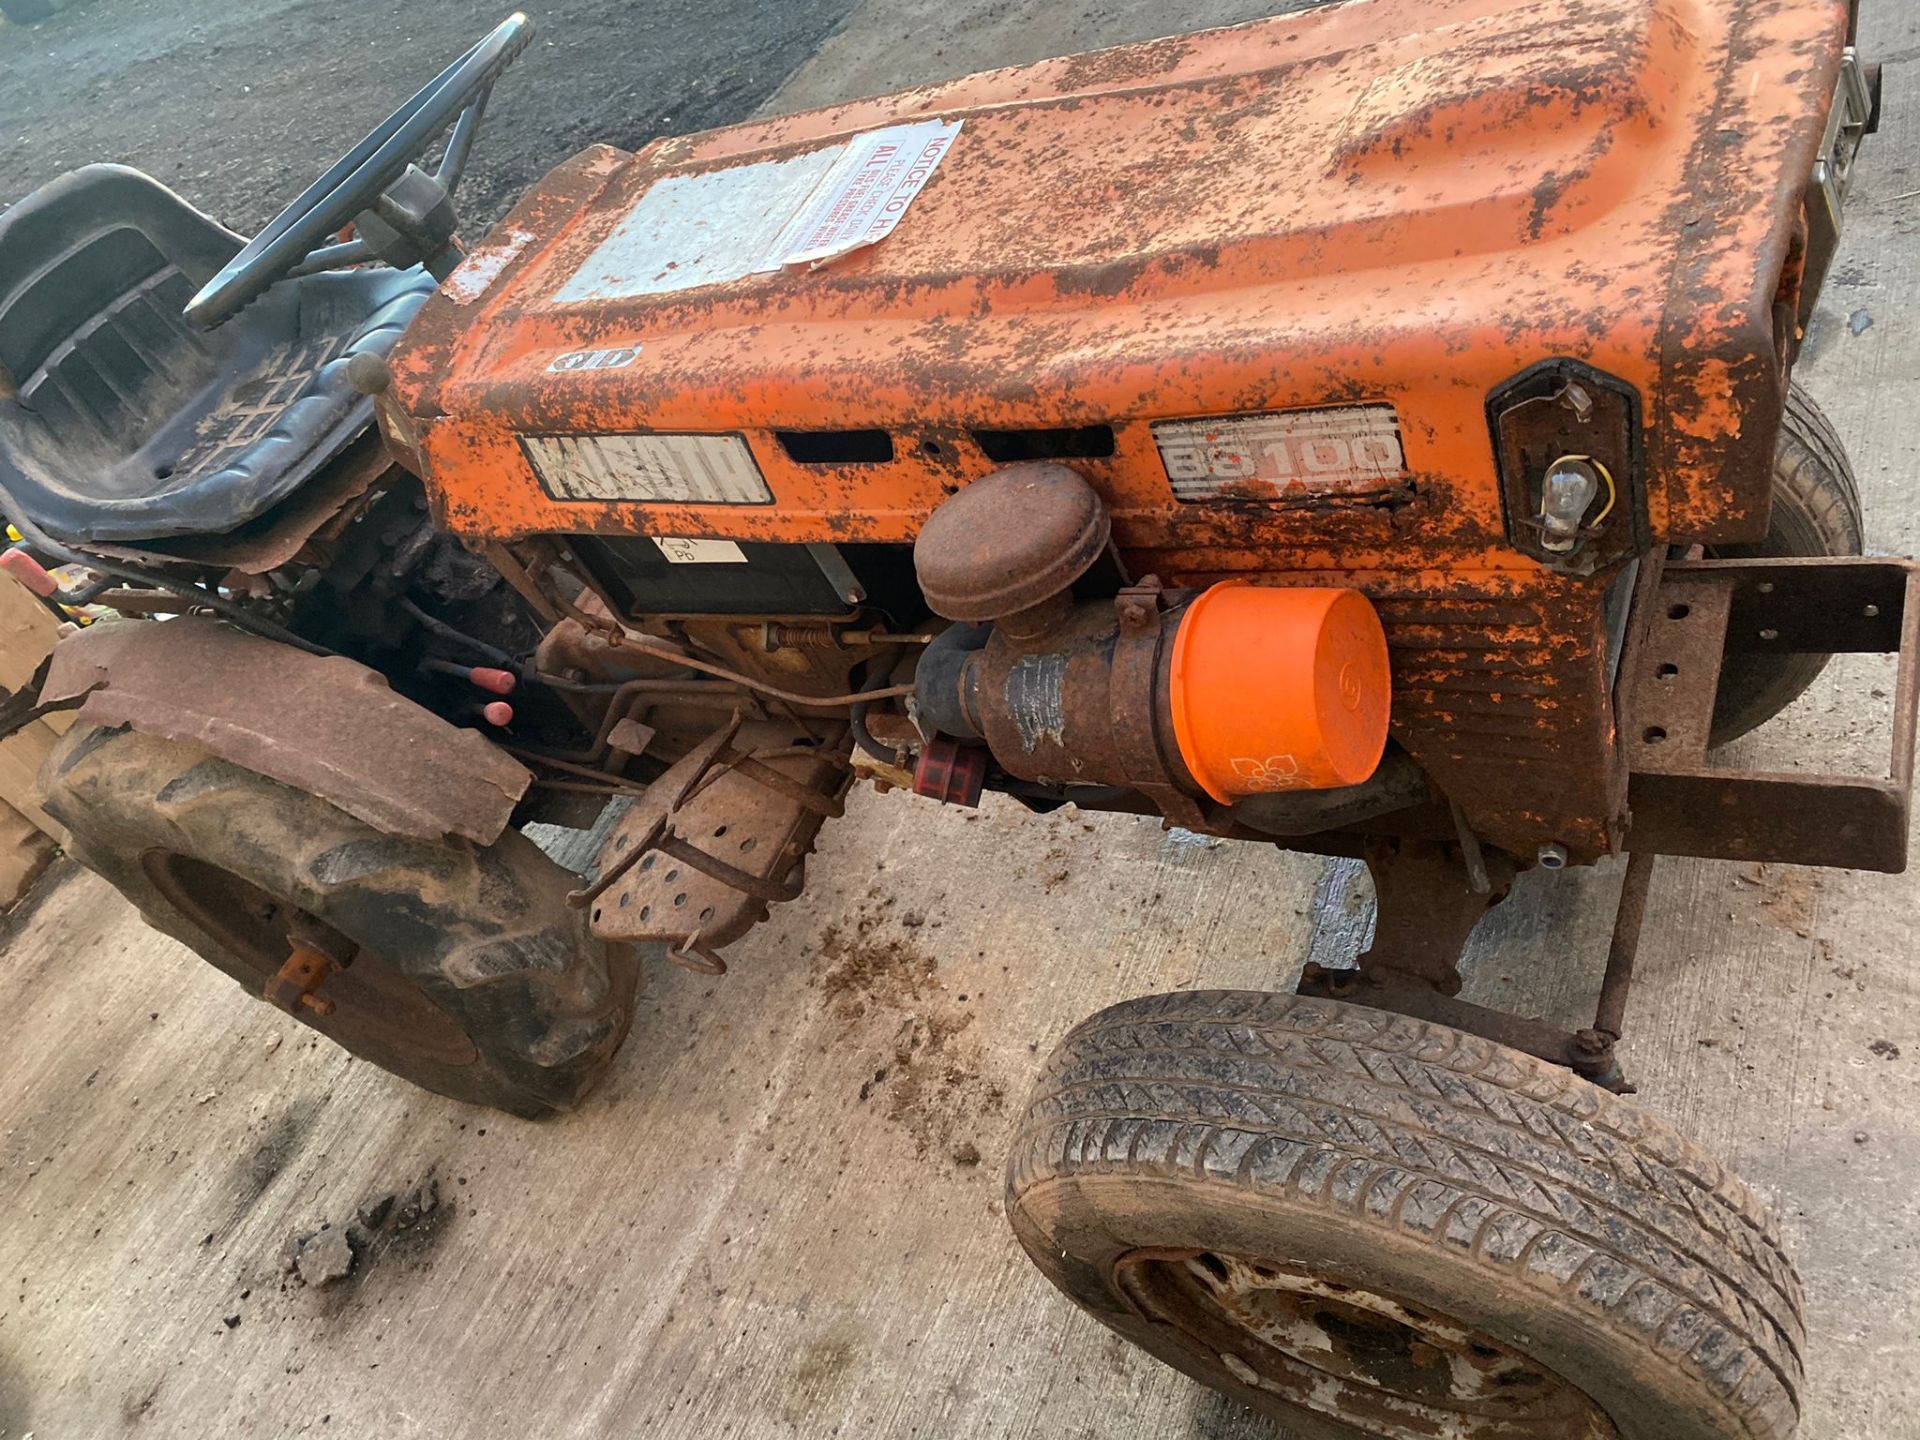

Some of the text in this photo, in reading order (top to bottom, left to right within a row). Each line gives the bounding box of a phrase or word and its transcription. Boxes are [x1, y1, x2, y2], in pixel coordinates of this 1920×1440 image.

[864, 145, 897, 168] ALL
[901, 136, 948, 189] NOTICE
[876, 159, 906, 189] PLEASE
[856, 190, 884, 217] CHECK
[885, 192, 911, 213] TO
[674, 549, 695, 561] Pb
